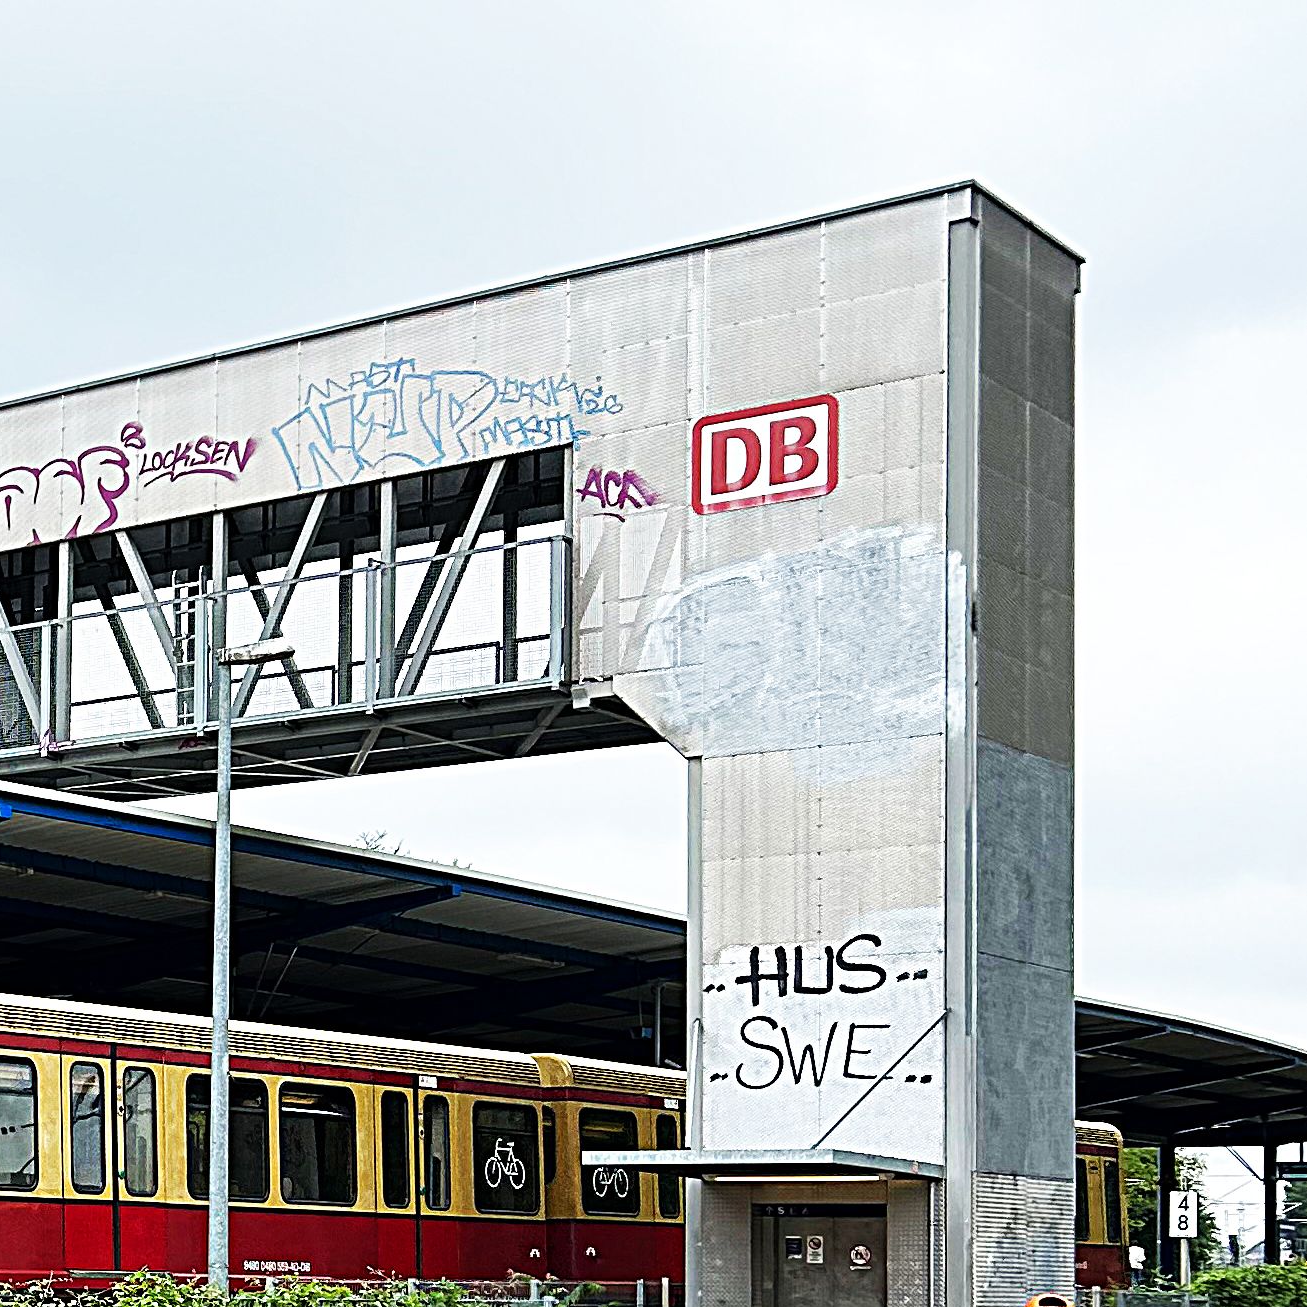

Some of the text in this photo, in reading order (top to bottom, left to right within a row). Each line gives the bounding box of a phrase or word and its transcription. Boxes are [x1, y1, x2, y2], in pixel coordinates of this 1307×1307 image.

[708, 413, 821, 497] DB
[735, 1014, 892, 1090] SWE
[1177, 1215, 1189, 1231] 8
